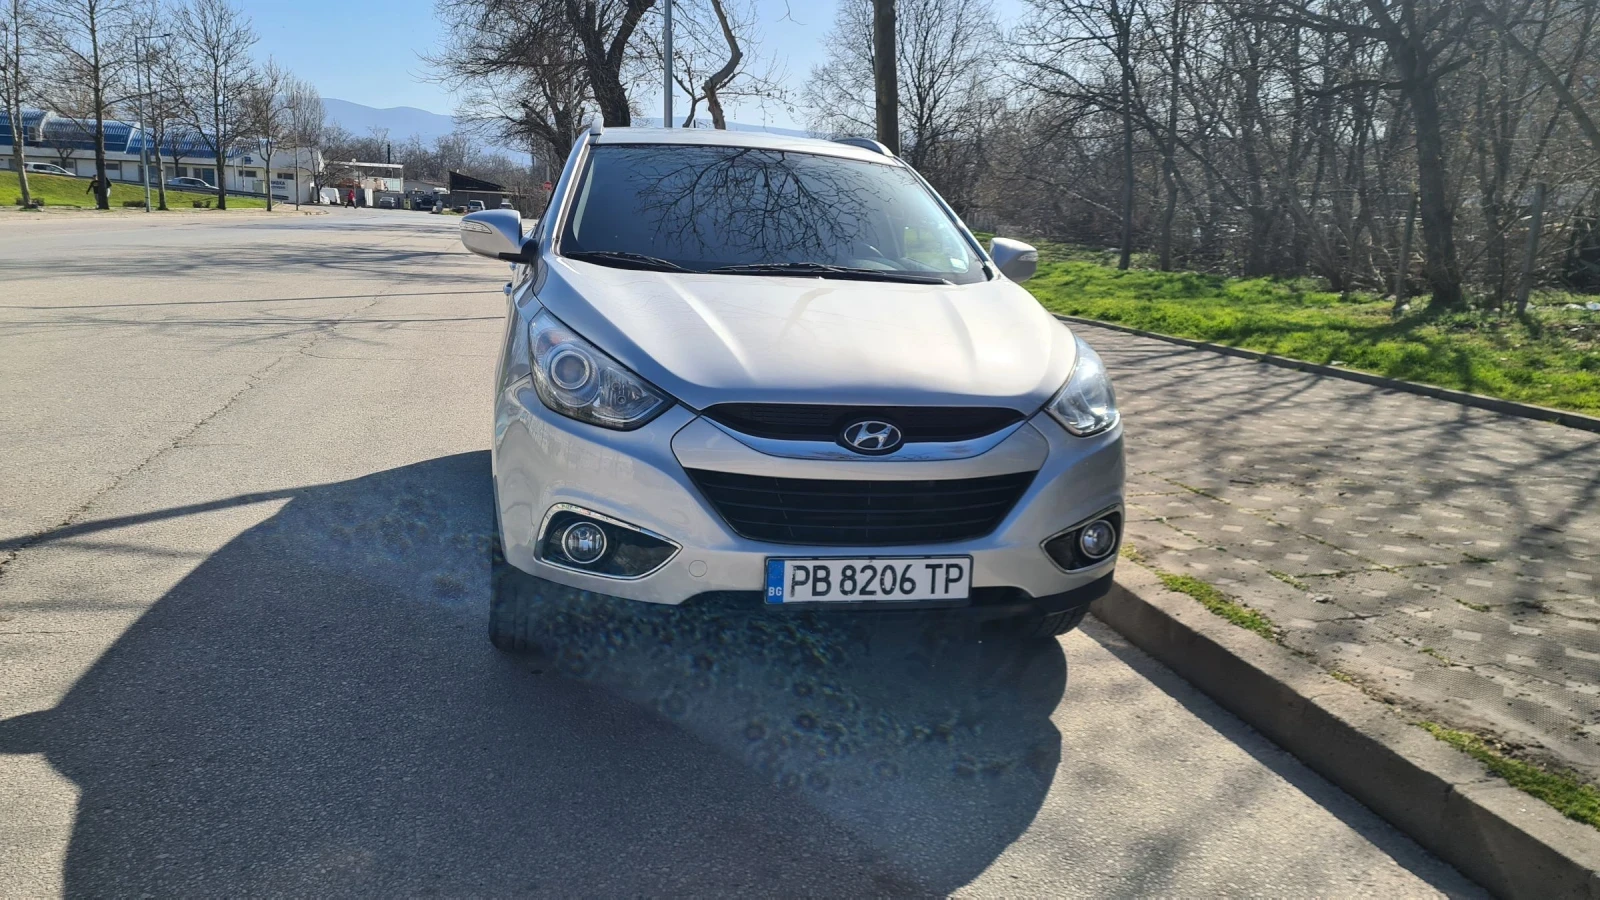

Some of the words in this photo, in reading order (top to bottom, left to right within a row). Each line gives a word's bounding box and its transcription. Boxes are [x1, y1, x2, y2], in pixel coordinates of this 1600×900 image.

[790, 564, 832, 597] PB
[839, 564, 917, 596] 8206
[925, 563, 964, 595] TP
[768, 587, 783, 597] BG
